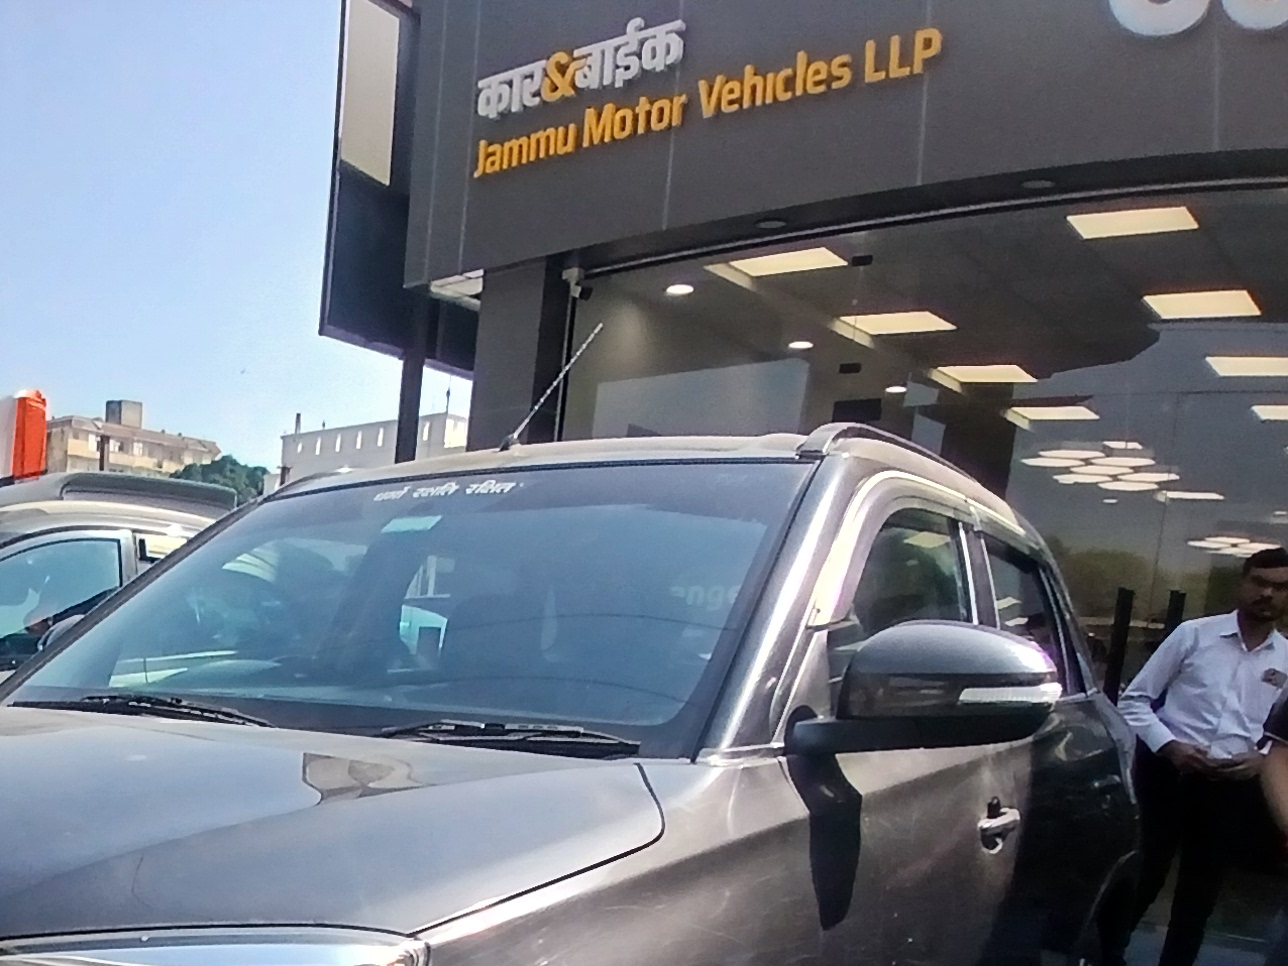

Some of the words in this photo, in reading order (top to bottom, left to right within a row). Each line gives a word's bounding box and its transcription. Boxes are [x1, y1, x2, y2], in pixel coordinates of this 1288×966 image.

[475, 123, 577, 177] Jammu
[582, 94, 687, 148] Motor
[698, 50, 852, 119] Vehicles
[864, 27, 942, 84] LLP
